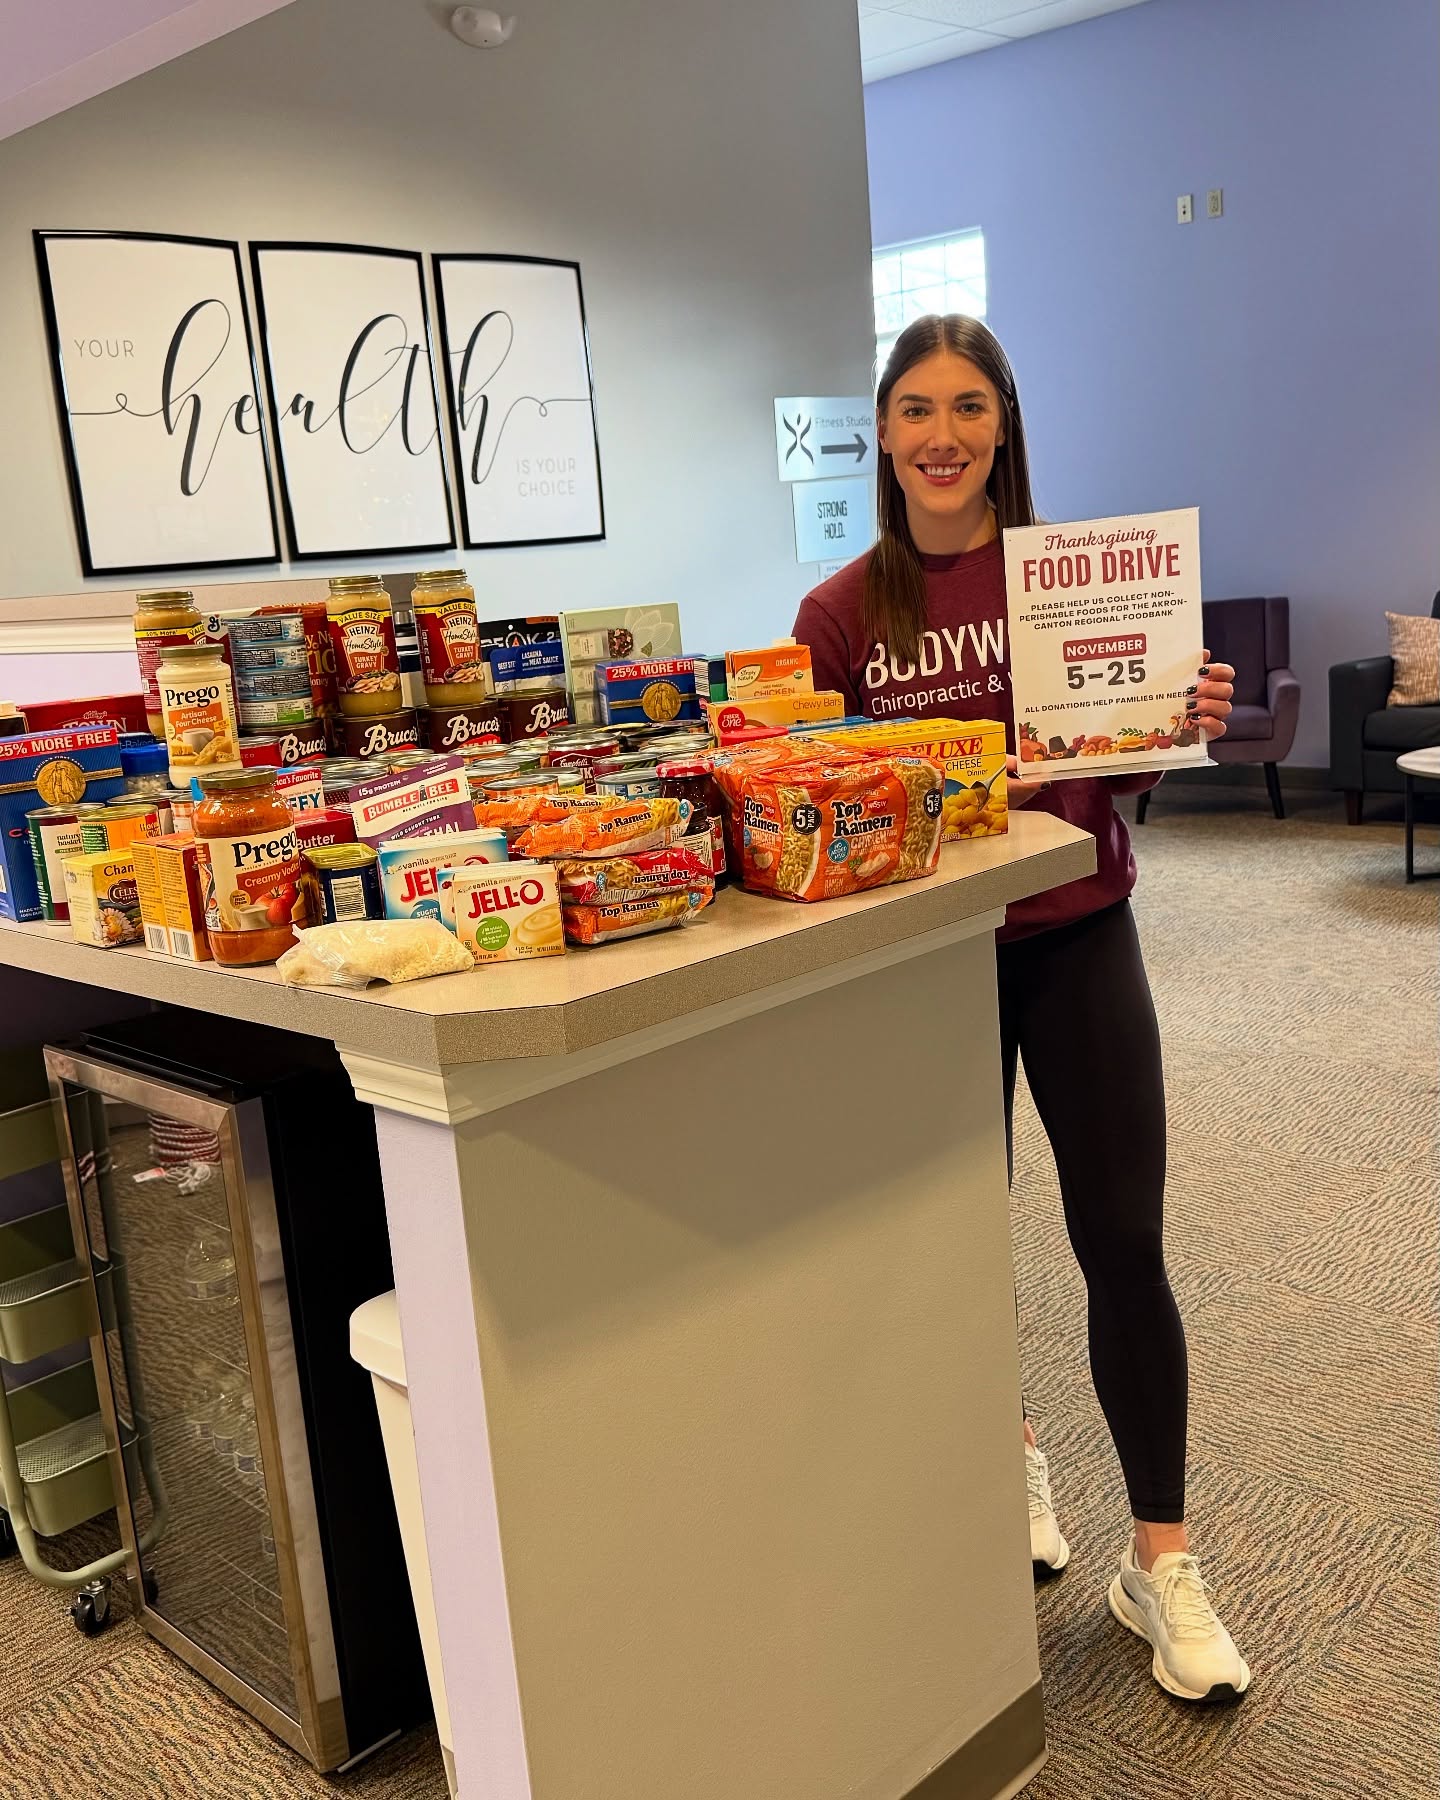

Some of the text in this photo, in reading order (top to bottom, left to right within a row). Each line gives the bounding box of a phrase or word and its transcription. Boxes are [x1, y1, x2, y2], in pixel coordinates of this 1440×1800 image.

[74, 338, 134, 358] YOUR
[814, 415, 872, 429] Fitness Studio
[515, 456, 576, 475] IS YOUR
[517, 480, 576, 497] CHOICE
[816, 500, 848, 519] STRONG
[1044, 528, 1158, 550] Thanksgiving
[1023, 543, 1181, 592] FOOD DRIVE
[438, 603, 461, 615] VALUE
[1031, 590, 1175, 611] PLEASE HELP US COLLECT NON-
[339, 611, 364, 624] VALUE
[1019, 598, 1188, 622] PERISHABLE FOODS FOR THE AKRON-
[448, 616, 472, 628] HEINZ
[1034, 609, 1174, 630] CANTON REGIONAL FOODBANK
[349, 625, 376, 637] HEINZ
[346, 637, 383, 653] HomeStyle
[453, 645, 474, 654] TURKEY
[1066, 639, 1144, 657] NOVEMBER
[353, 655, 378, 664] TURKEY
[455, 652, 474, 660] GRAVY
[521, 650, 543, 660] LASAGNA
[529, 658, 542, 667] MEAT
[542, 655, 560, 665] SAUCE
[775, 657, 799, 667] ORGANIC
[355, 661, 377, 669] GRAVY
[611, 667, 638, 679] 25%
[640, 661, 674, 676] MORE
[1067, 659, 1146, 690] 5-25
[165, 685, 220, 708] Prego
[871, 679, 983, 715] Chiropractic
[987, 674, 1005, 693] &
[792, 697, 842, 711] Chewy Bars
[1025, 706, 1040, 714] ALL
[1041, 701, 1091, 712] DONATIONS
[1093, 698, 1114, 707] HELP
[1115, 694, 1154, 704] FAMILIES
[175, 714, 217, 728] Four Cheese
[181, 708, 207, 719] Artisan
[441, 713, 500, 746] Bruce's
[31, 736, 74, 754] MORE
[77, 730, 112, 747] FREE
[279, 732, 327, 763] Bruce's
[359, 723, 418, 756] Bruce's
[945, 757, 982, 772] CHEESE
[967, 769, 988, 777] Dinner
[292, 771, 319, 782] Favorite
[373, 779, 401, 793] PROTEIN
[367, 781, 452, 820] BUMBLE BEE
[551, 799, 569, 809] Top
[744, 796, 764, 818] Top
[926, 794, 935, 813] 5
[795, 808, 816, 828] 5 PACK
[831, 800, 863, 820] Top
[390, 829, 404, 840] WILD
[425, 814, 441, 824] TUNA
[613, 811, 652, 827] Ramen
[744, 811, 780, 834] Ramen
[833, 814, 894, 837] Ramen
[231, 831, 297, 868] Prego
[297, 834, 335, 850] Butter
[403, 858, 430, 870] vanilla
[651, 863, 671, 874] BEEF
[244, 871, 281, 888] Creamy
[472, 879, 498, 889] vanilla
[633, 869, 691, 884] Top Ramen
[467, 879, 545, 919] JELL-O
[416, 907, 439, 918] SUGAR
[600, 899, 660, 918] Top Ramen
[619, 911, 645, 922] CHICKEN
